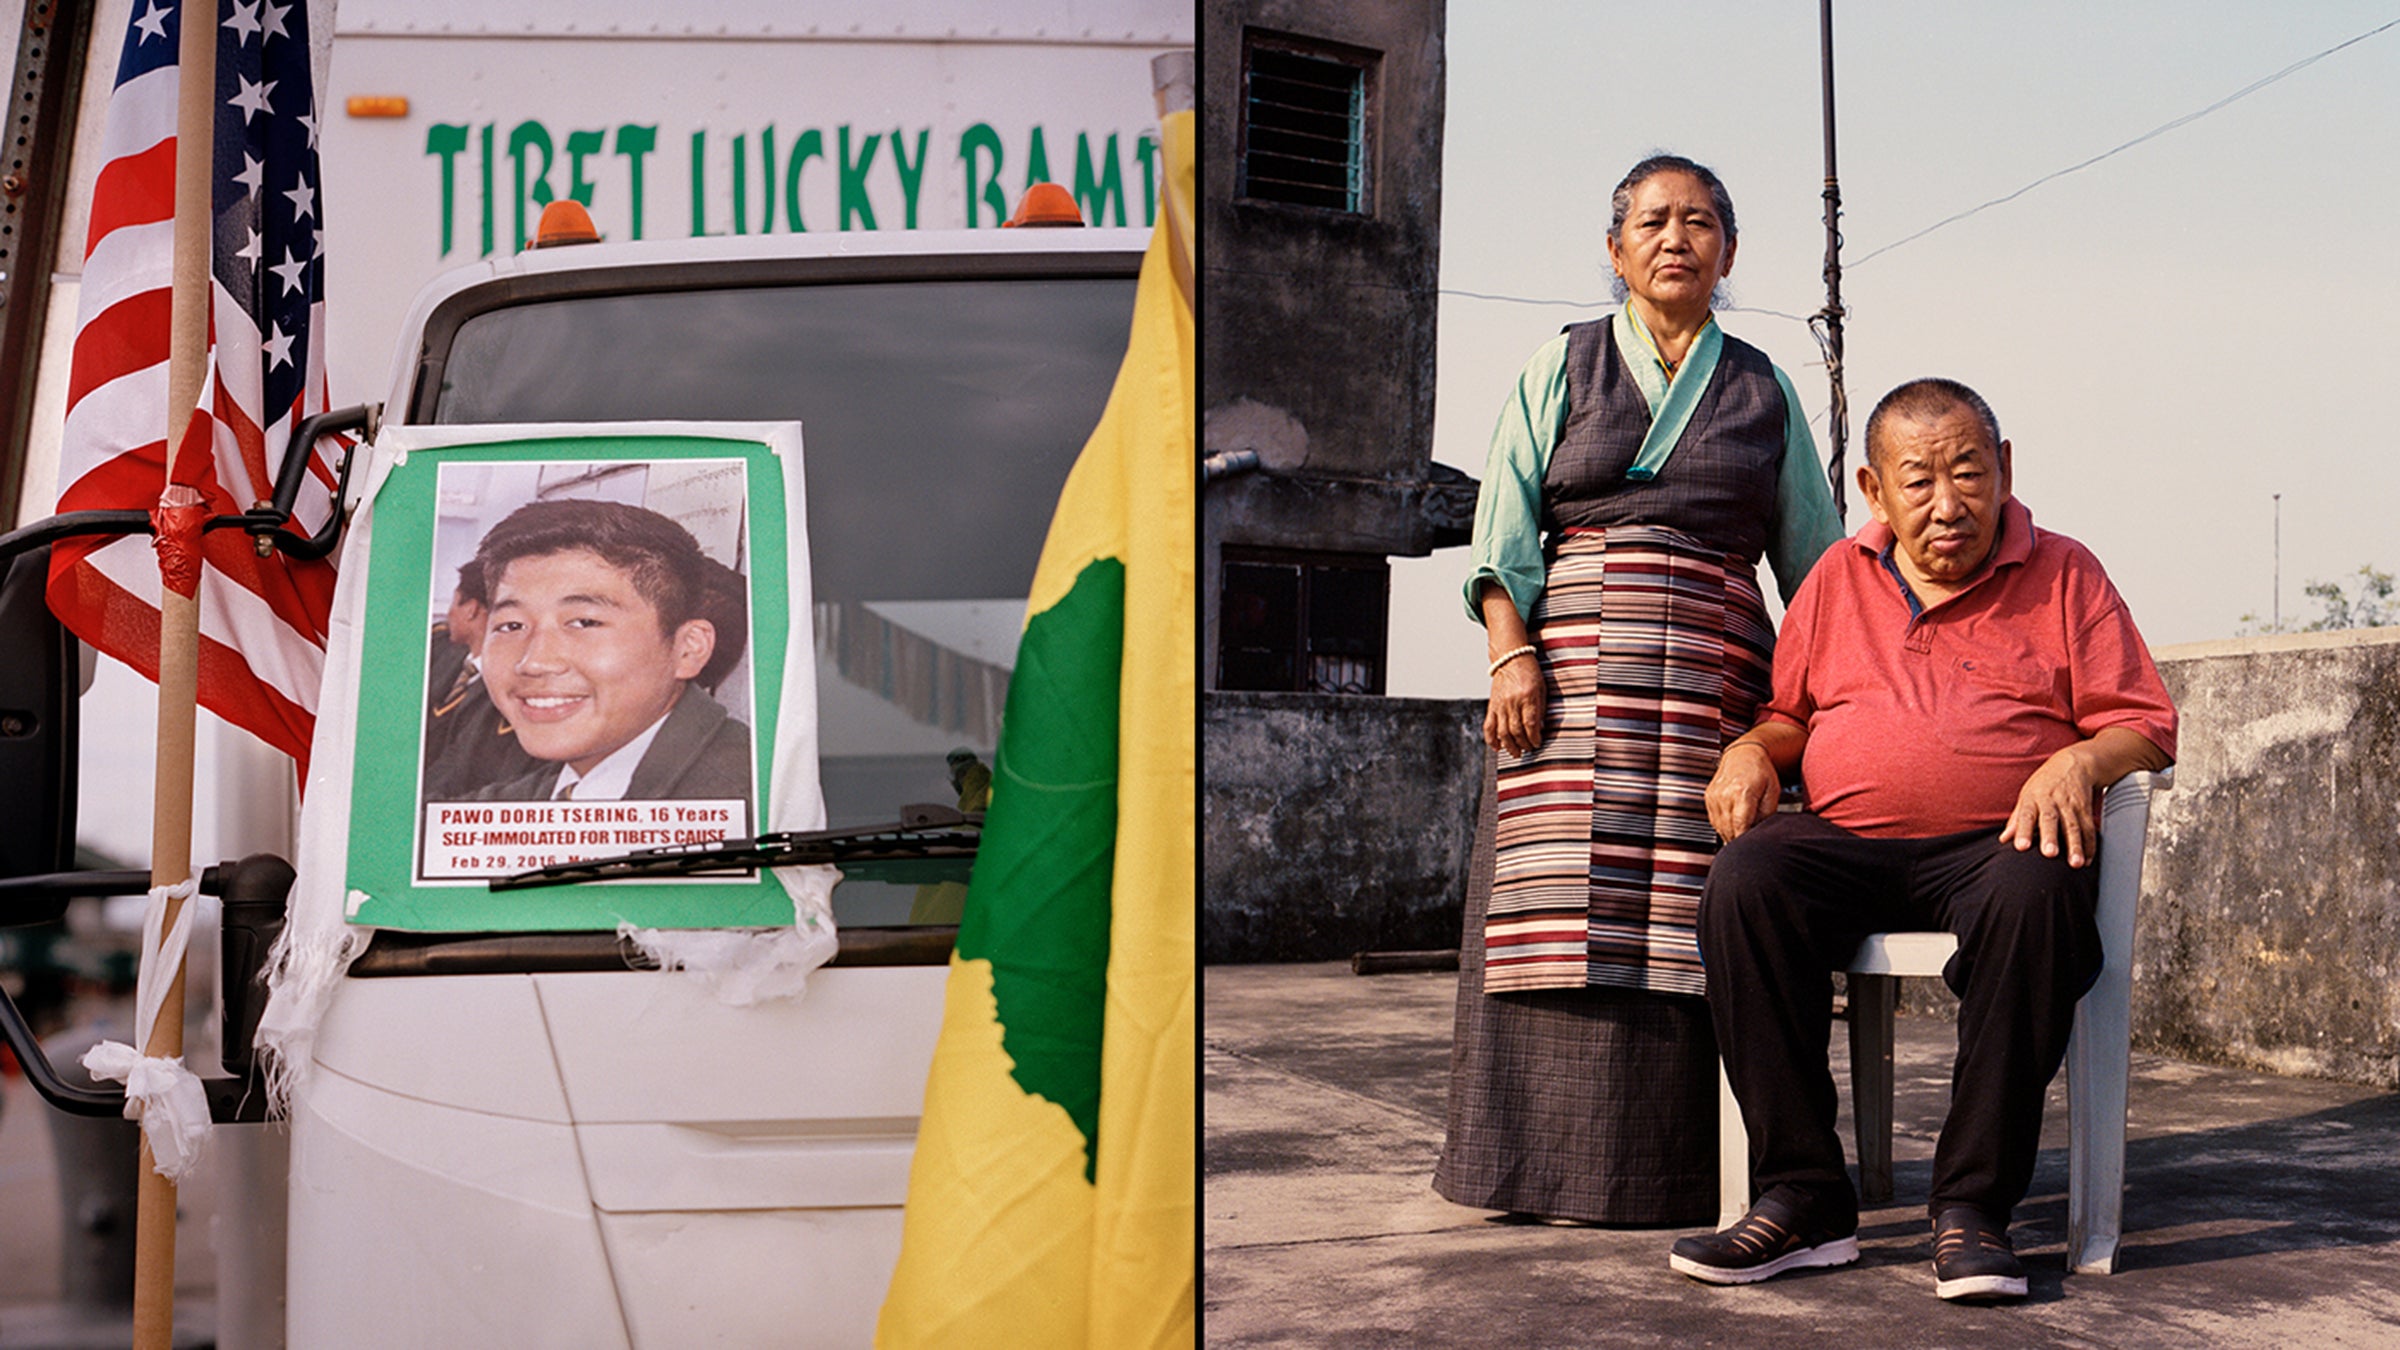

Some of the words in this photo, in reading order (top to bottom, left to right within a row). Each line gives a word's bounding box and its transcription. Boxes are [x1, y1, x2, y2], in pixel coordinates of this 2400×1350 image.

[425, 120, 658, 259] TIBET
[689, 124, 931, 237] LUCKY
[441, 809, 493, 824] PAWO
[500, 808, 554, 823] DORJE
[561, 807, 643, 823] TSERING,
[650, 807, 669, 822] 16
[676, 807, 729, 822] Years
[442, 831, 576, 846] SELF-IMMOLATED
[580, 830, 609, 844] FOR
[613, 829, 670, 844] TIBET'S
[674, 829, 726, 844] CAUSE
[451, 856, 480, 868] Feb
[517, 855, 557, 868] 2016
